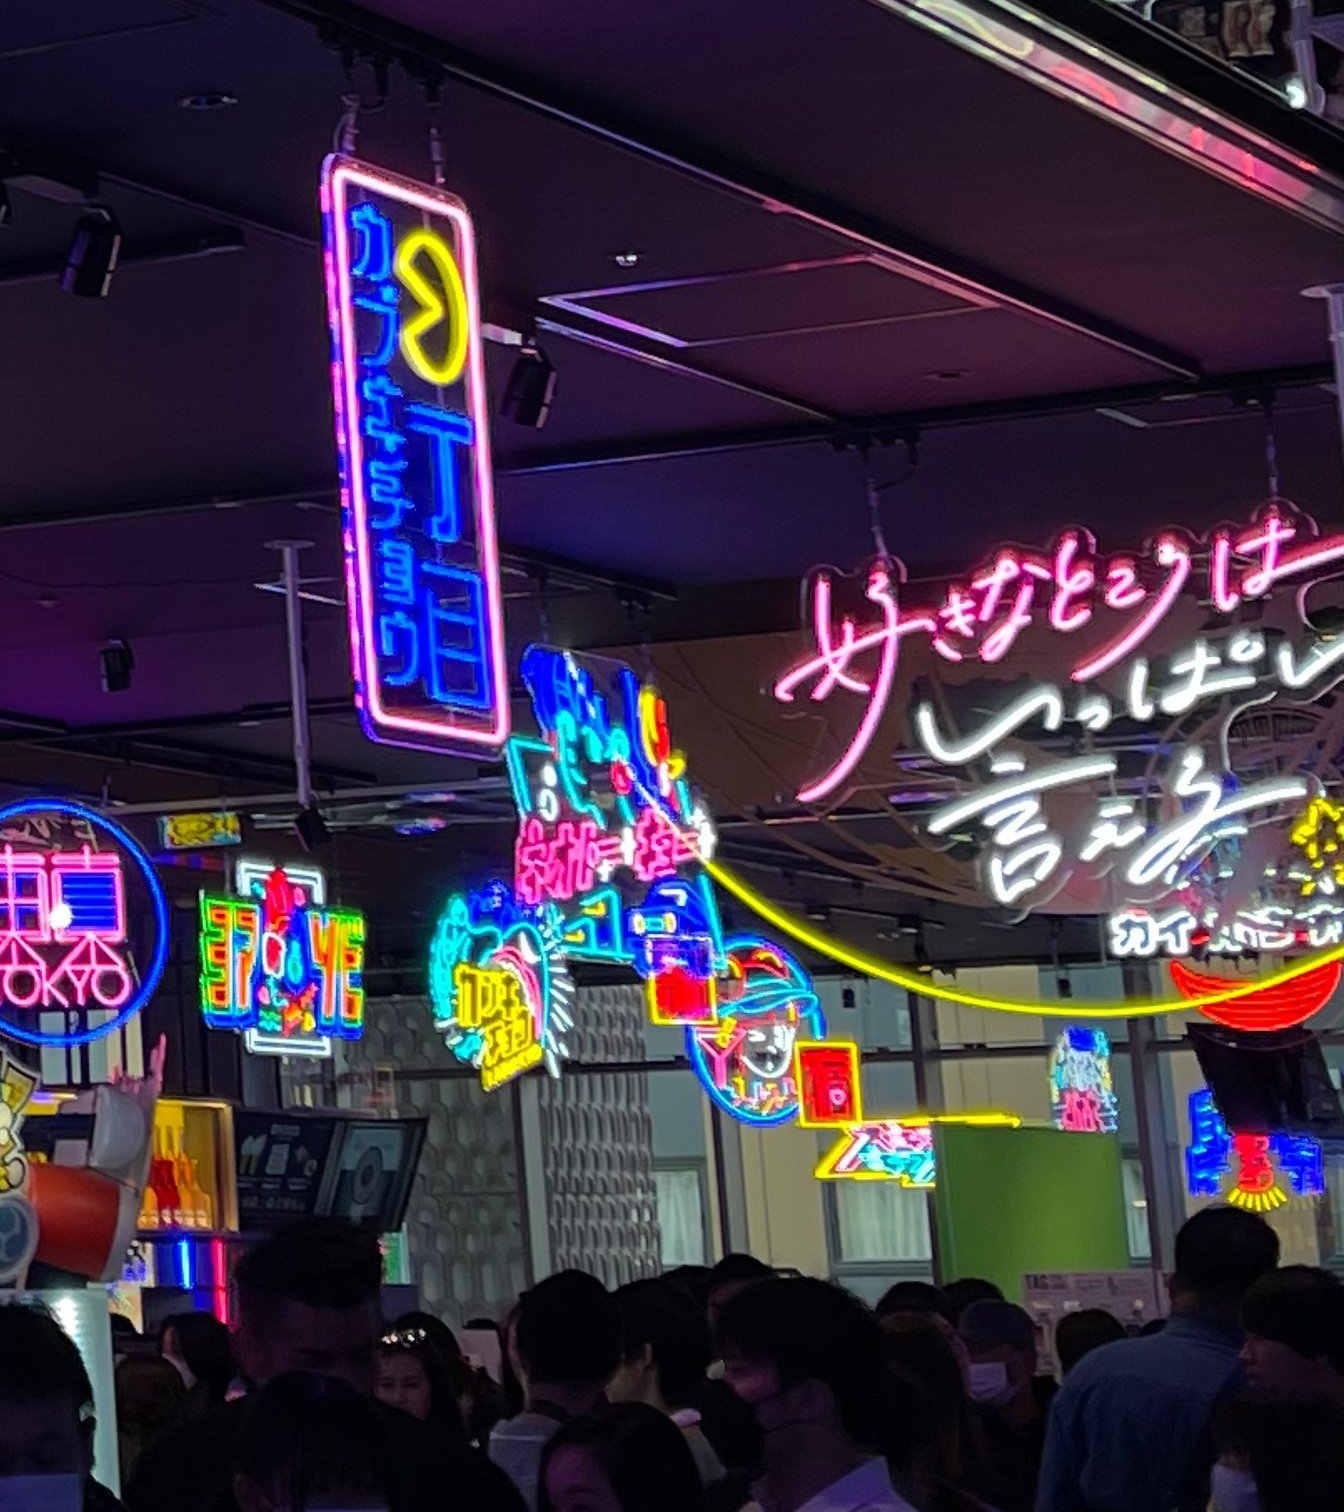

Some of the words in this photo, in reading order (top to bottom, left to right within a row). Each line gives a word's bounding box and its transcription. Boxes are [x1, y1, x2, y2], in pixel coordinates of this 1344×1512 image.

[774, 517, 1344, 803] 好きなところは
